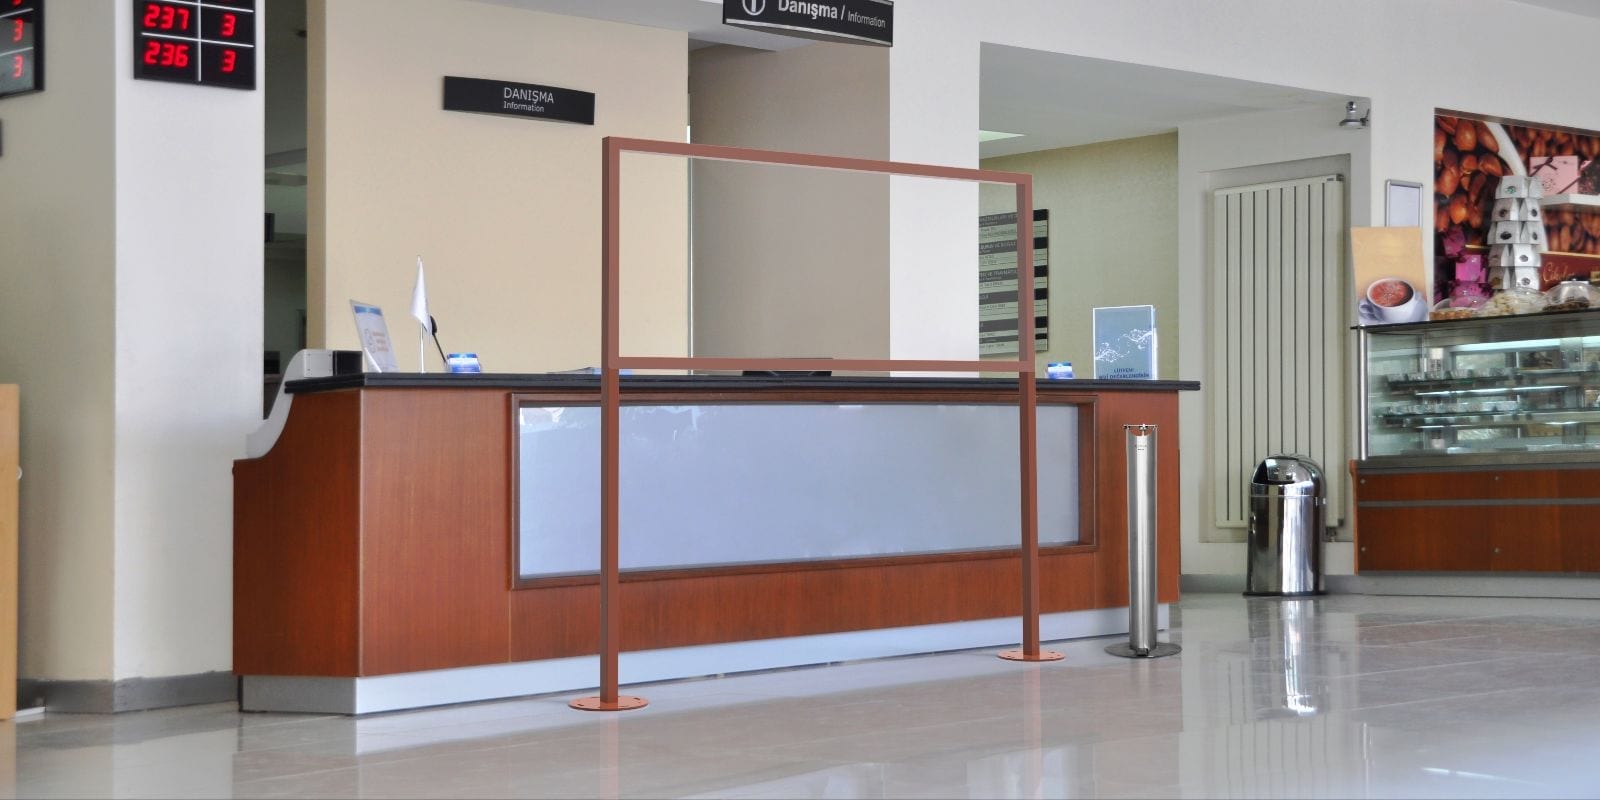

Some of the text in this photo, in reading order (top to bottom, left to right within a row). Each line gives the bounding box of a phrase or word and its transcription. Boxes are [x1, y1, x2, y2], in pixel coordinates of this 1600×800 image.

[143, 4, 236, 37] 237 3
[778, 0, 838, 19] Danışma
[847, 10, 886, 28] Information
[13, 18, 24, 42] 3
[13, 55, 24, 78] 3
[143, 40, 236, 72] 236 3
[503, 87, 554, 104] DANIŞMA
[503, 101, 545, 112] Information
